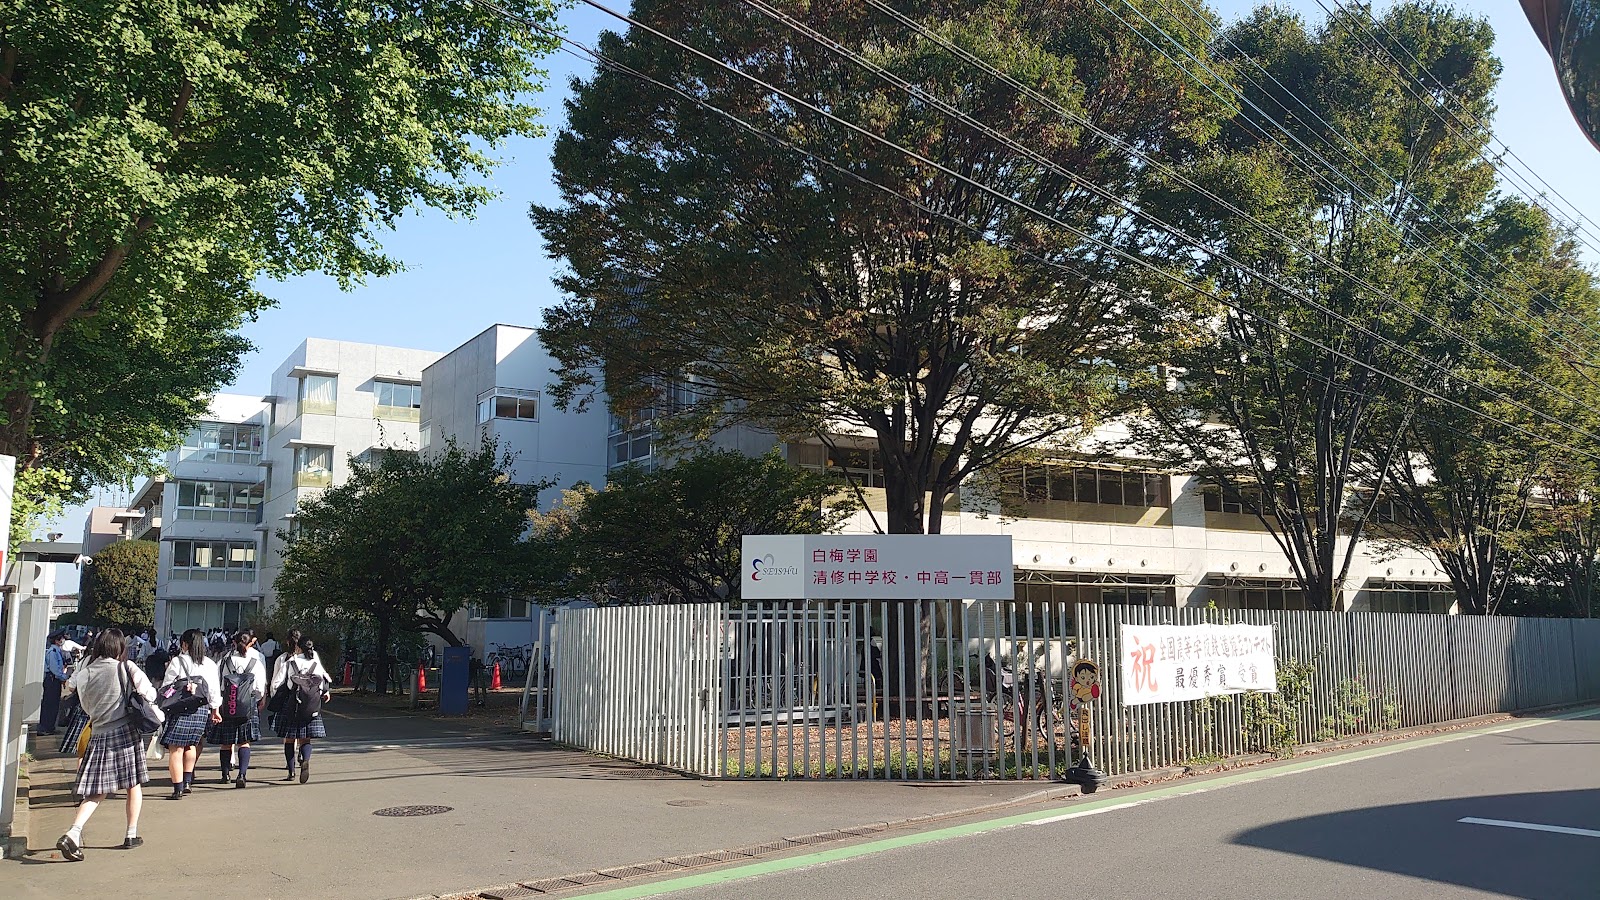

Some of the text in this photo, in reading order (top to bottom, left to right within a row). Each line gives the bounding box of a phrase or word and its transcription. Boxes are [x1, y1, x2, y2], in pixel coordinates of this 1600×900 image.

[812, 548, 878, 563] 白梅学園
[762, 565, 798, 576] SEISHU
[813, 570, 1002, 585] 清修中学校・中高一貫部
[1130, 635, 1158, 693] 祝
[1175, 662, 1258, 688] 最優秀賞 受賞
[228, 684, 238, 715] adidas
